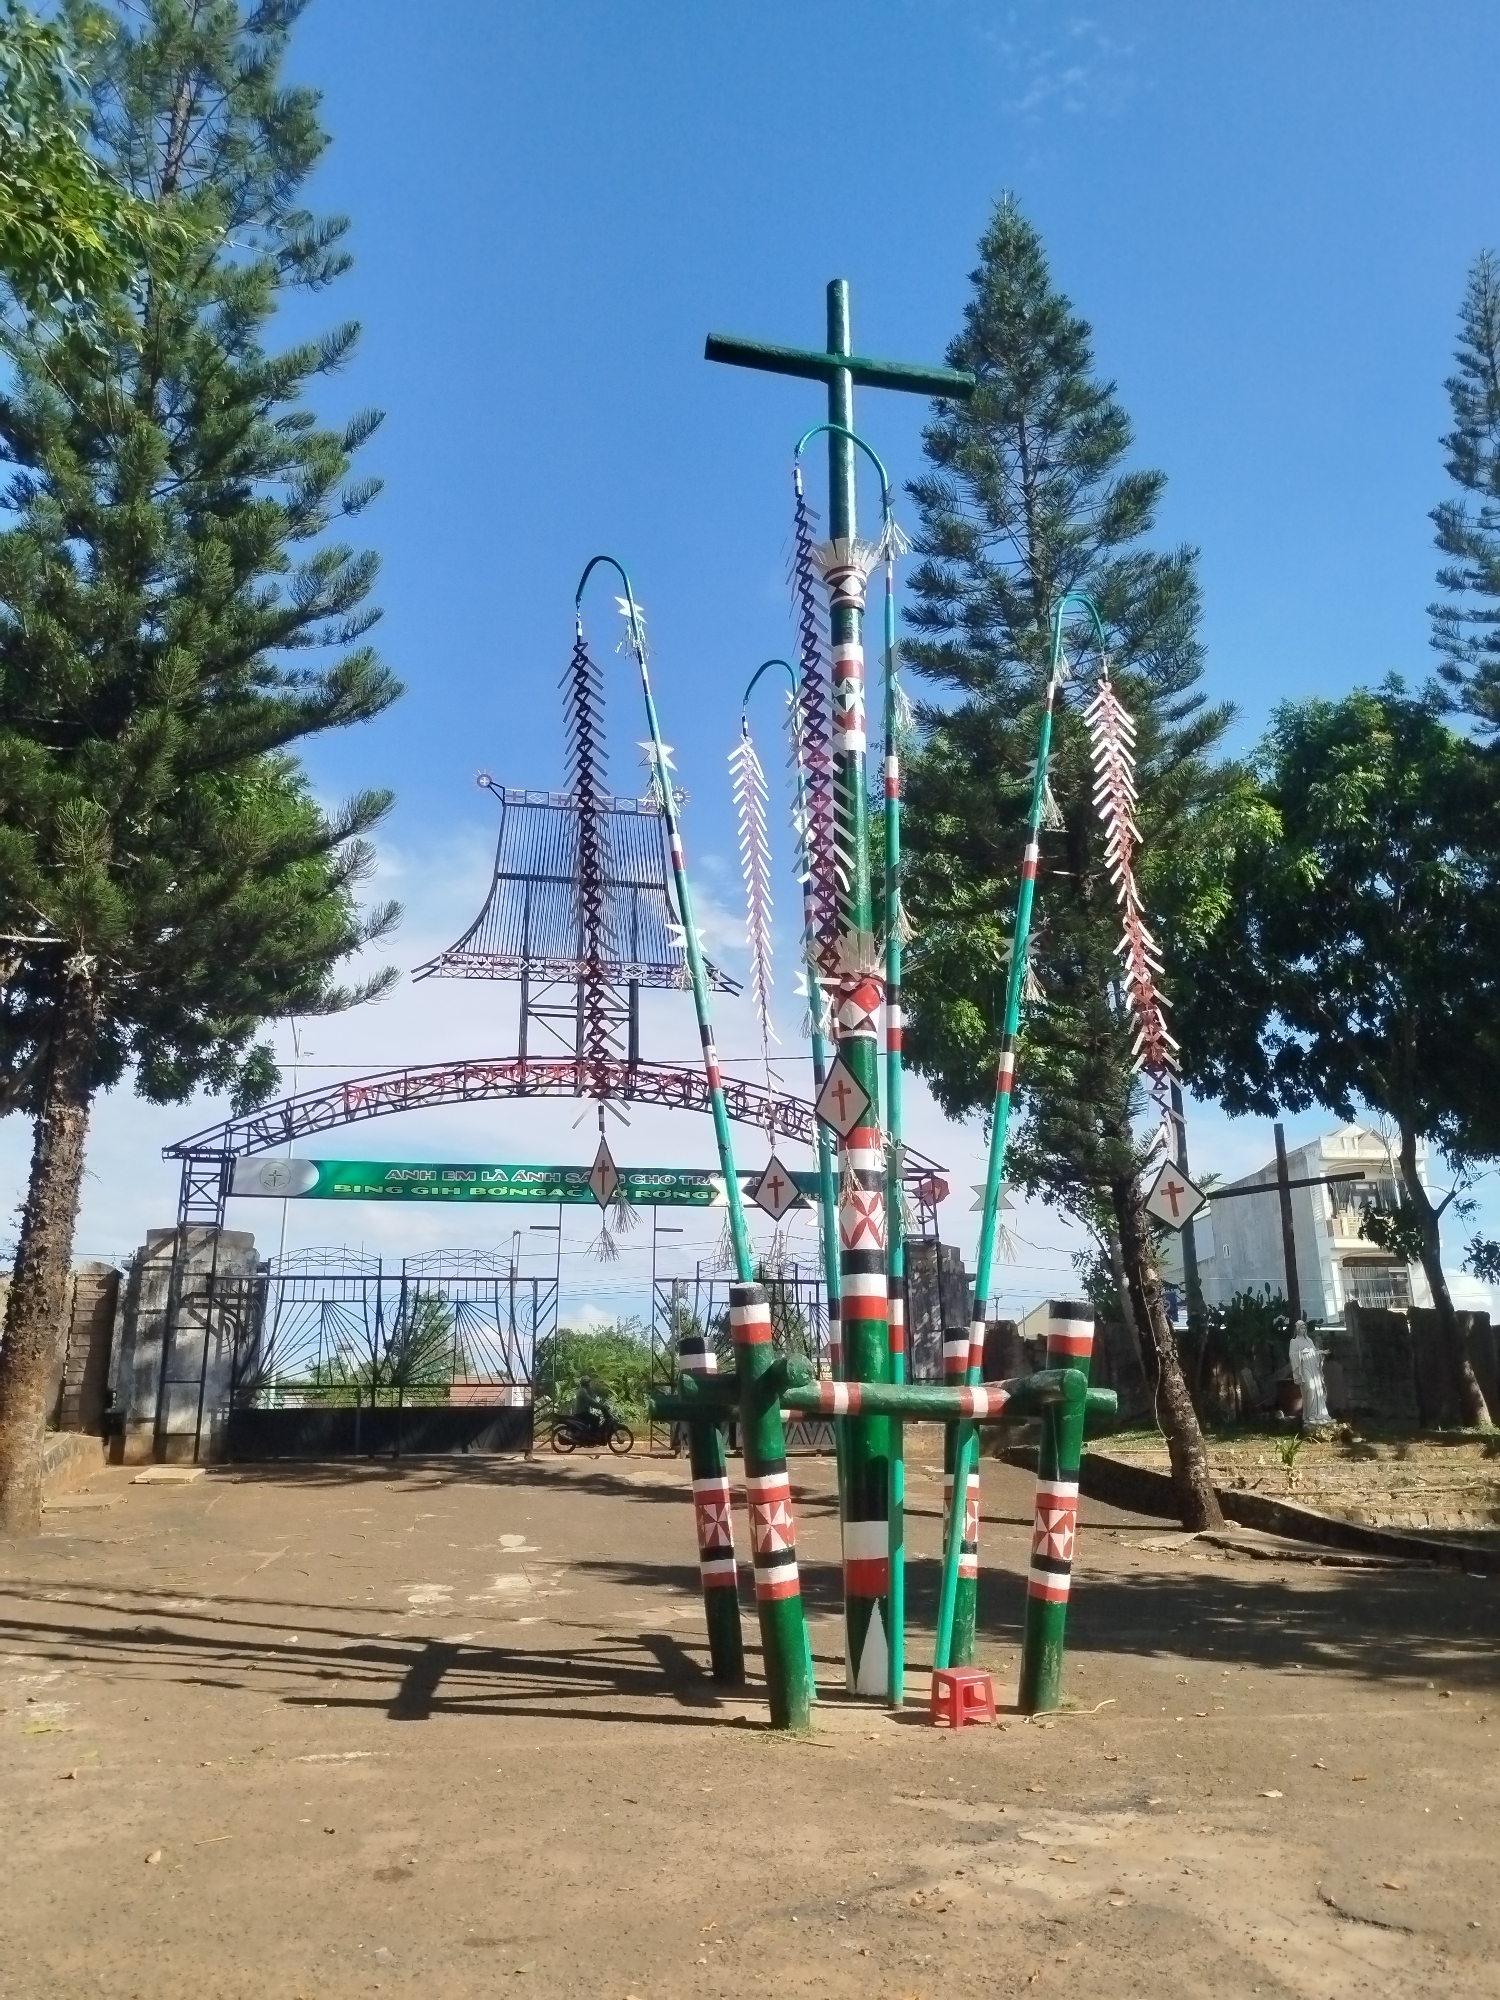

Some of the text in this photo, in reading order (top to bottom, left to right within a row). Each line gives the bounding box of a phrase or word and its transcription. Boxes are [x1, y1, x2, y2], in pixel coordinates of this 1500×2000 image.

[385, 1169, 436, 1181] ANH
[442, 1171, 477, 1182] EM
[481, 1169, 509, 1182] LÀ
[511, 1169, 561, 1183] ÁNH
[629, 1174, 677, 1186] CHO
[333, 1184, 404, 1194] BING
[411, 1186, 461, 1195] GIH
